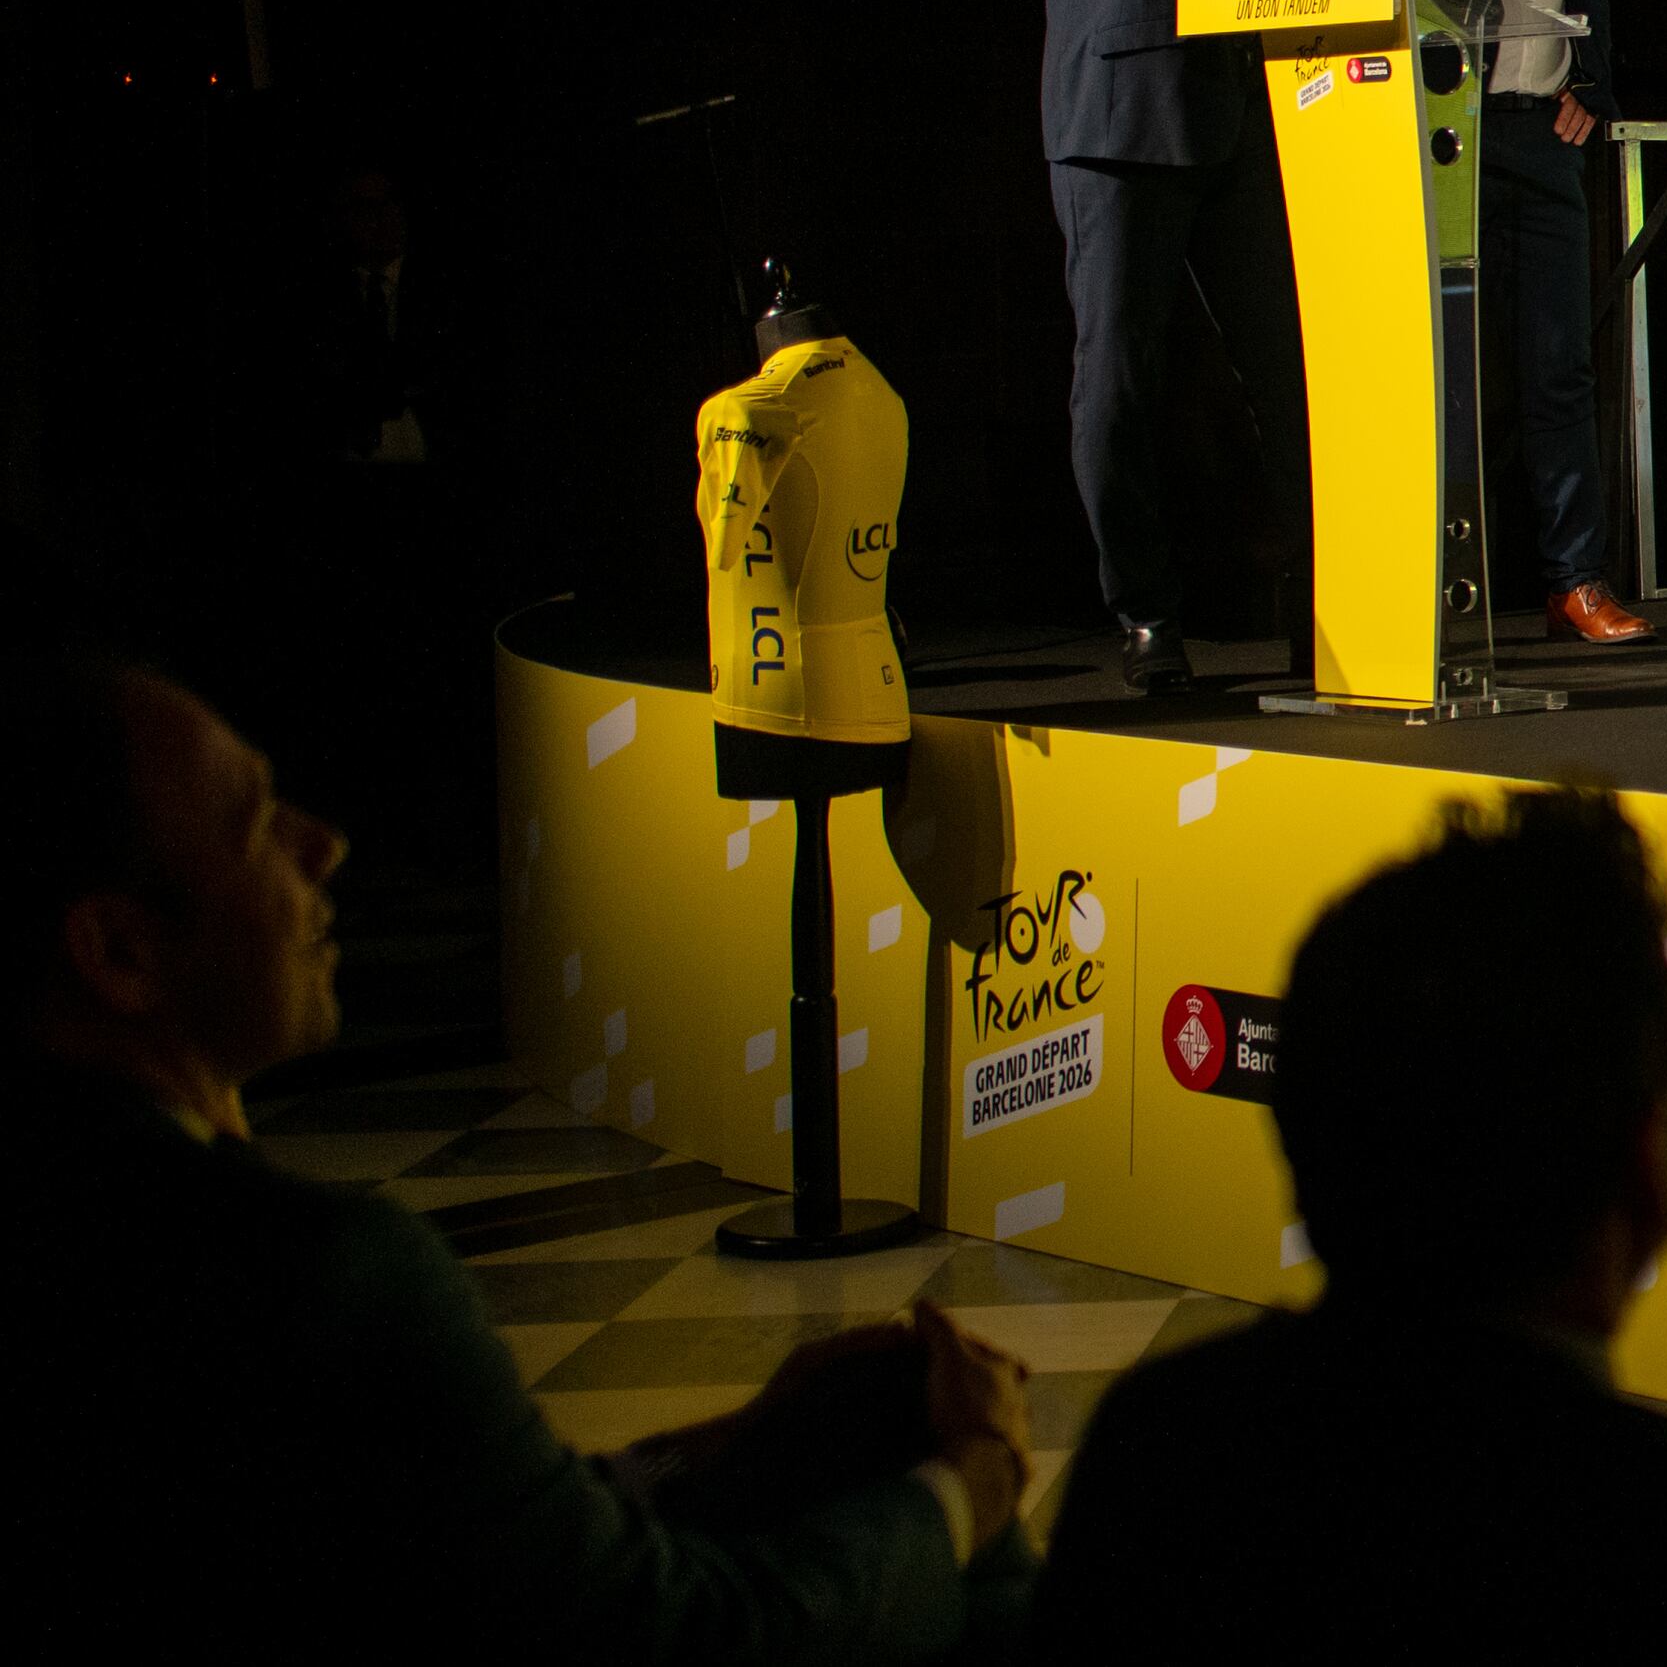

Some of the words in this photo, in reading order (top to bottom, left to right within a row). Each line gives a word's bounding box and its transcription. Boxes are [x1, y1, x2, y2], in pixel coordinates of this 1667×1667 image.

[1236, 0, 1253, 20] UN
[744, 503, 774, 577] CL
[851, 523, 890, 556] LCL
[751, 606, 786, 686] LCL
[1052, 934, 1071, 967] de
[973, 1073, 1055, 1126] BARCELONE
[1059, 1059, 1092, 1098] 2026
[976, 1055, 1027, 1094] GRAND
[1032, 1029, 1090, 1077] DÉPART
